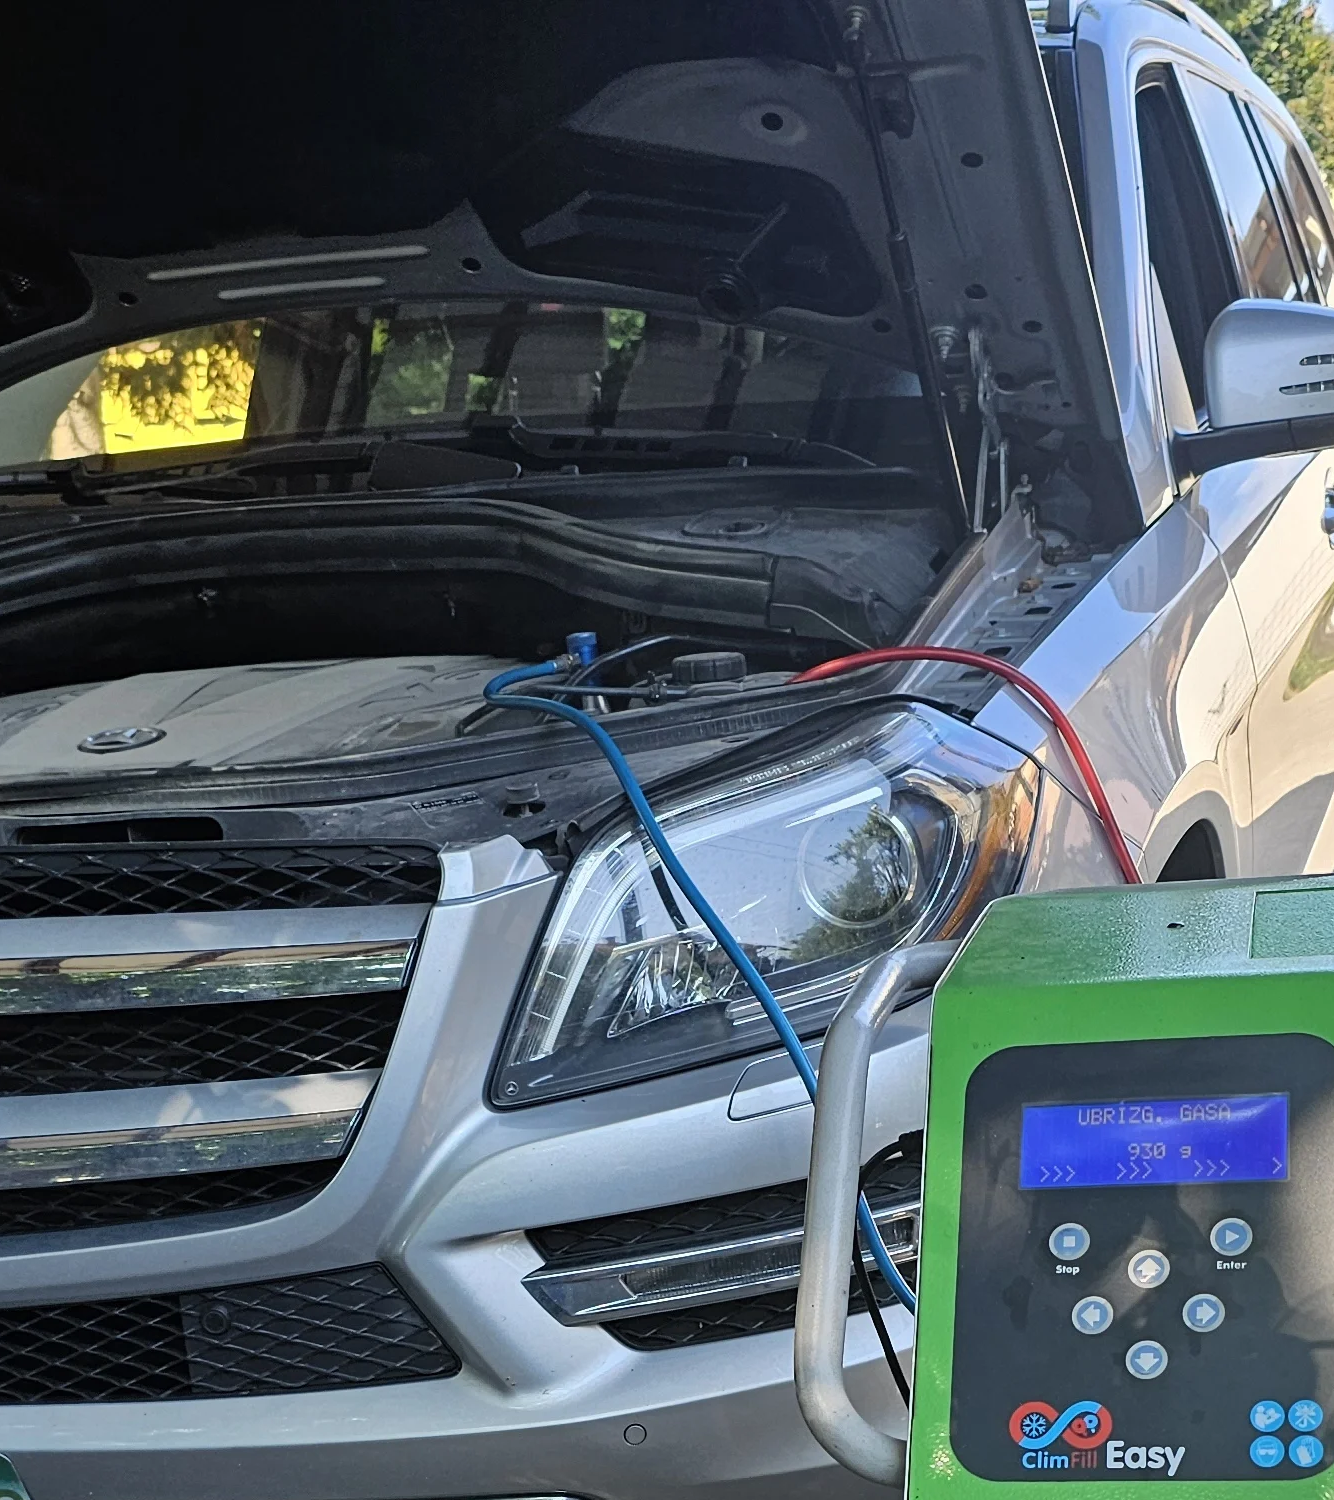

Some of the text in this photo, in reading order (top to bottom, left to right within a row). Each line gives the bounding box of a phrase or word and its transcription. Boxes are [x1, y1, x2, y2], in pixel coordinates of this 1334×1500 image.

[1180, 1103, 1231, 1121] GASA
[1128, 1143, 1166, 1160] 930
[1055, 1265, 1080, 1275] Stop
[1217, 1261, 1248, 1270] Enter
[1106, 1440, 1186, 1477] Easy
